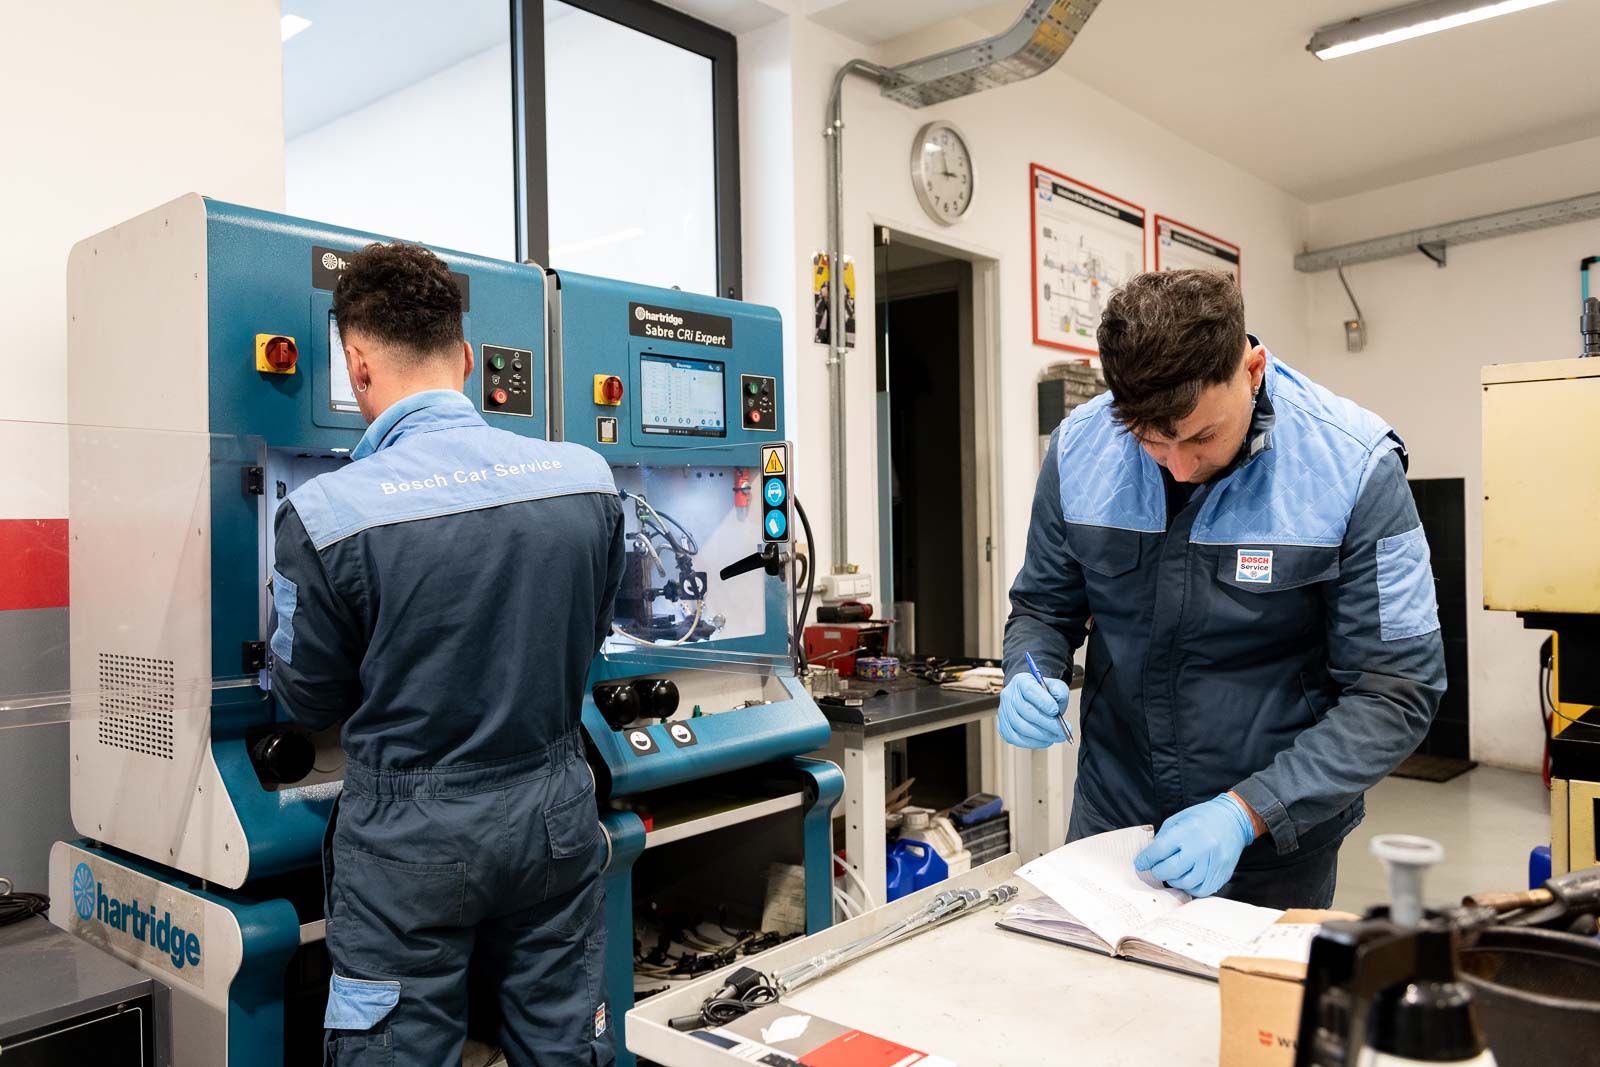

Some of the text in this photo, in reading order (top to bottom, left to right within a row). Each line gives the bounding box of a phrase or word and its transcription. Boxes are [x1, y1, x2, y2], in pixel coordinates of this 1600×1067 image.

[645, 309, 684, 326] hartridge
[645, 323, 727, 346] Sabre CRi Expert
[380, 458, 563, 495] Bosch Car Service
[1240, 563, 1269, 571] Service
[1241, 556, 1269, 564] BOSCH
[96, 882, 201, 970] hartridge
